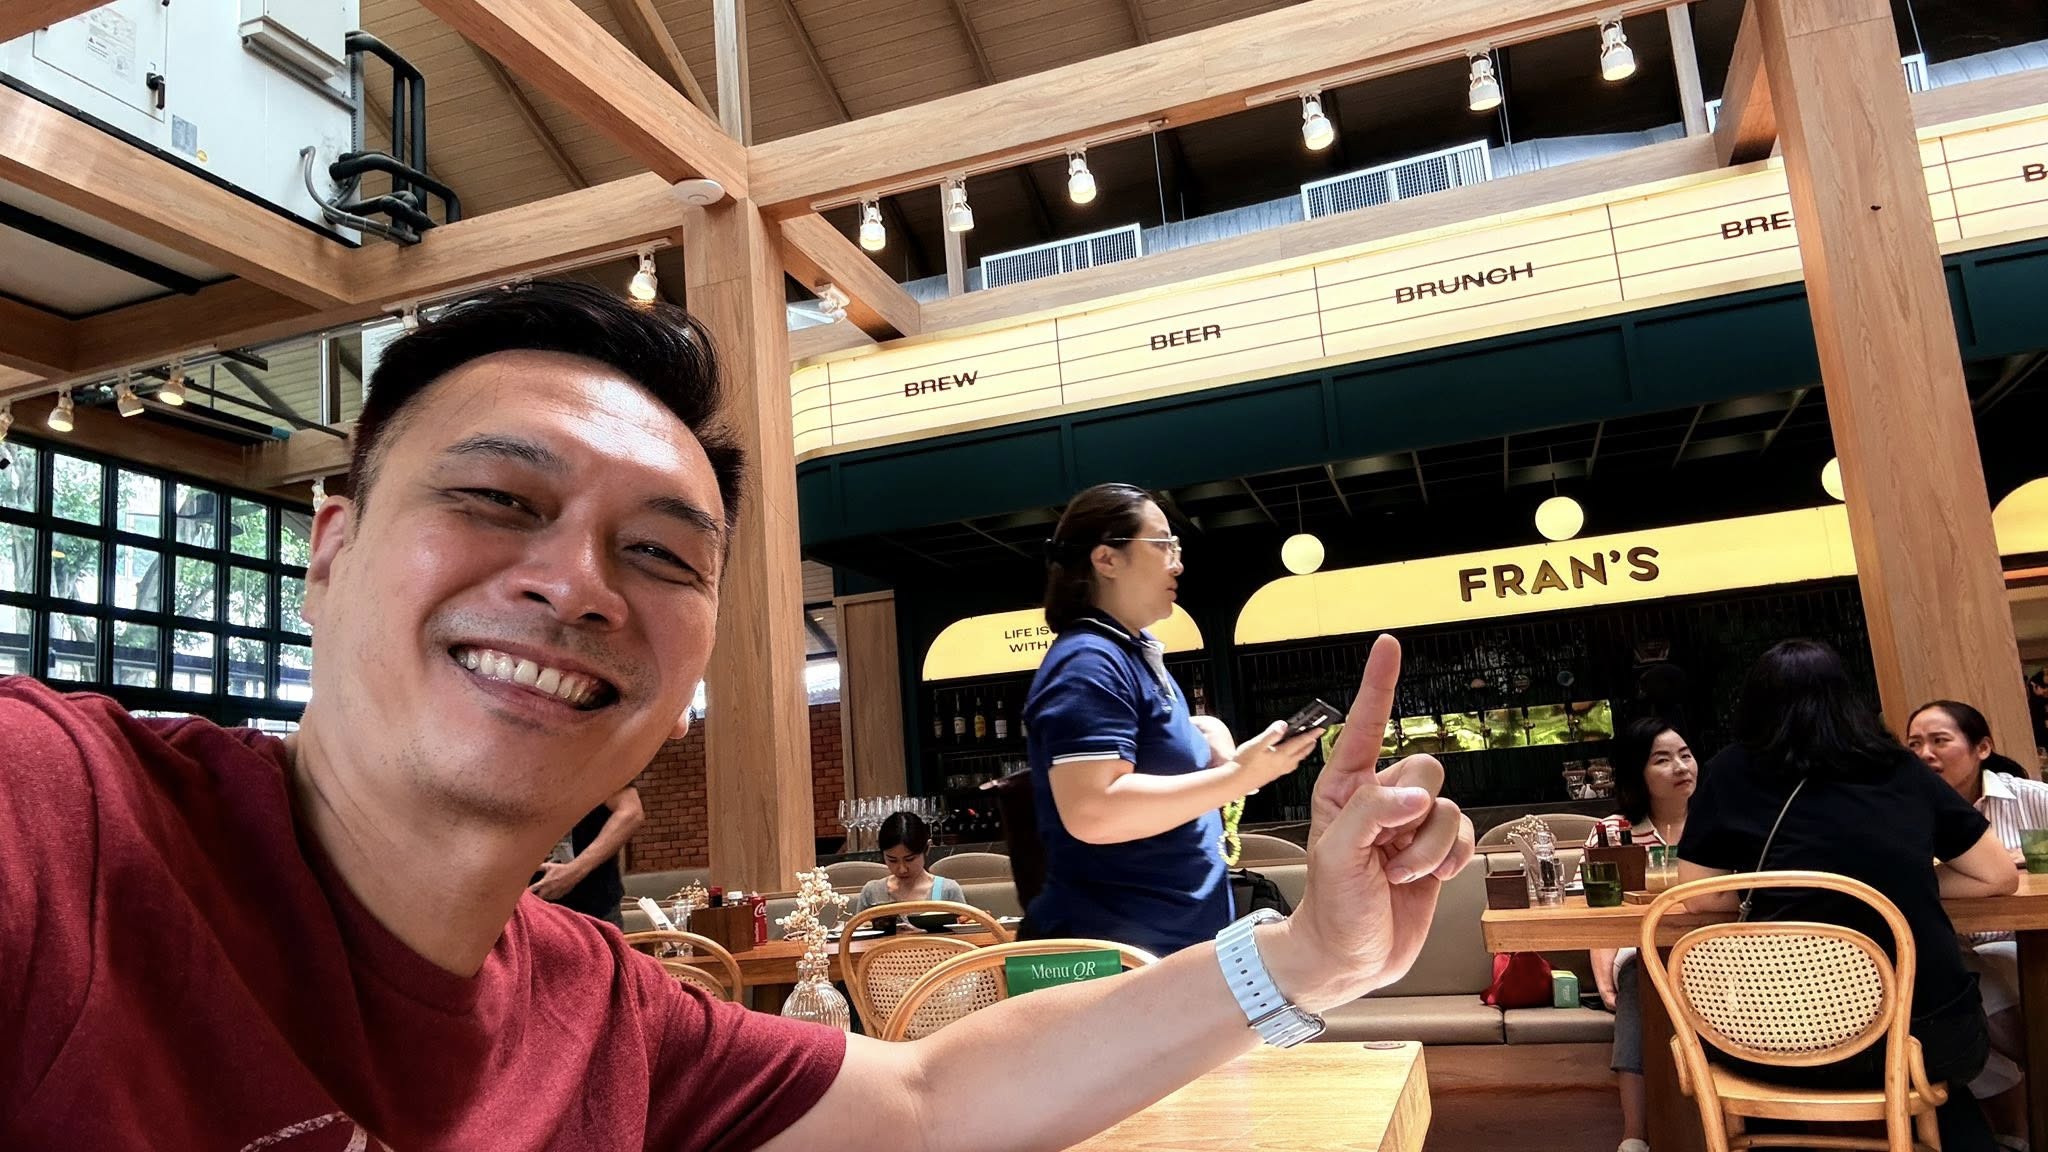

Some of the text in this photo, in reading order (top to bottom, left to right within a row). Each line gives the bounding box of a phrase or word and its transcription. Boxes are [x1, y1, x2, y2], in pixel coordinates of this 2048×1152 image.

[1721, 211, 1791, 240] BRE
[1394, 261, 1534, 305] BRUNCH
[1150, 324, 1222, 351] BEER
[904, 370, 978, 398] BREW
[1458, 546, 1661, 602] FRAN'S
[1004, 626, 1050, 639] LIFE IS
[1009, 640, 1048, 653] WITH
[1031, 961, 1096, 980] Menu QR
